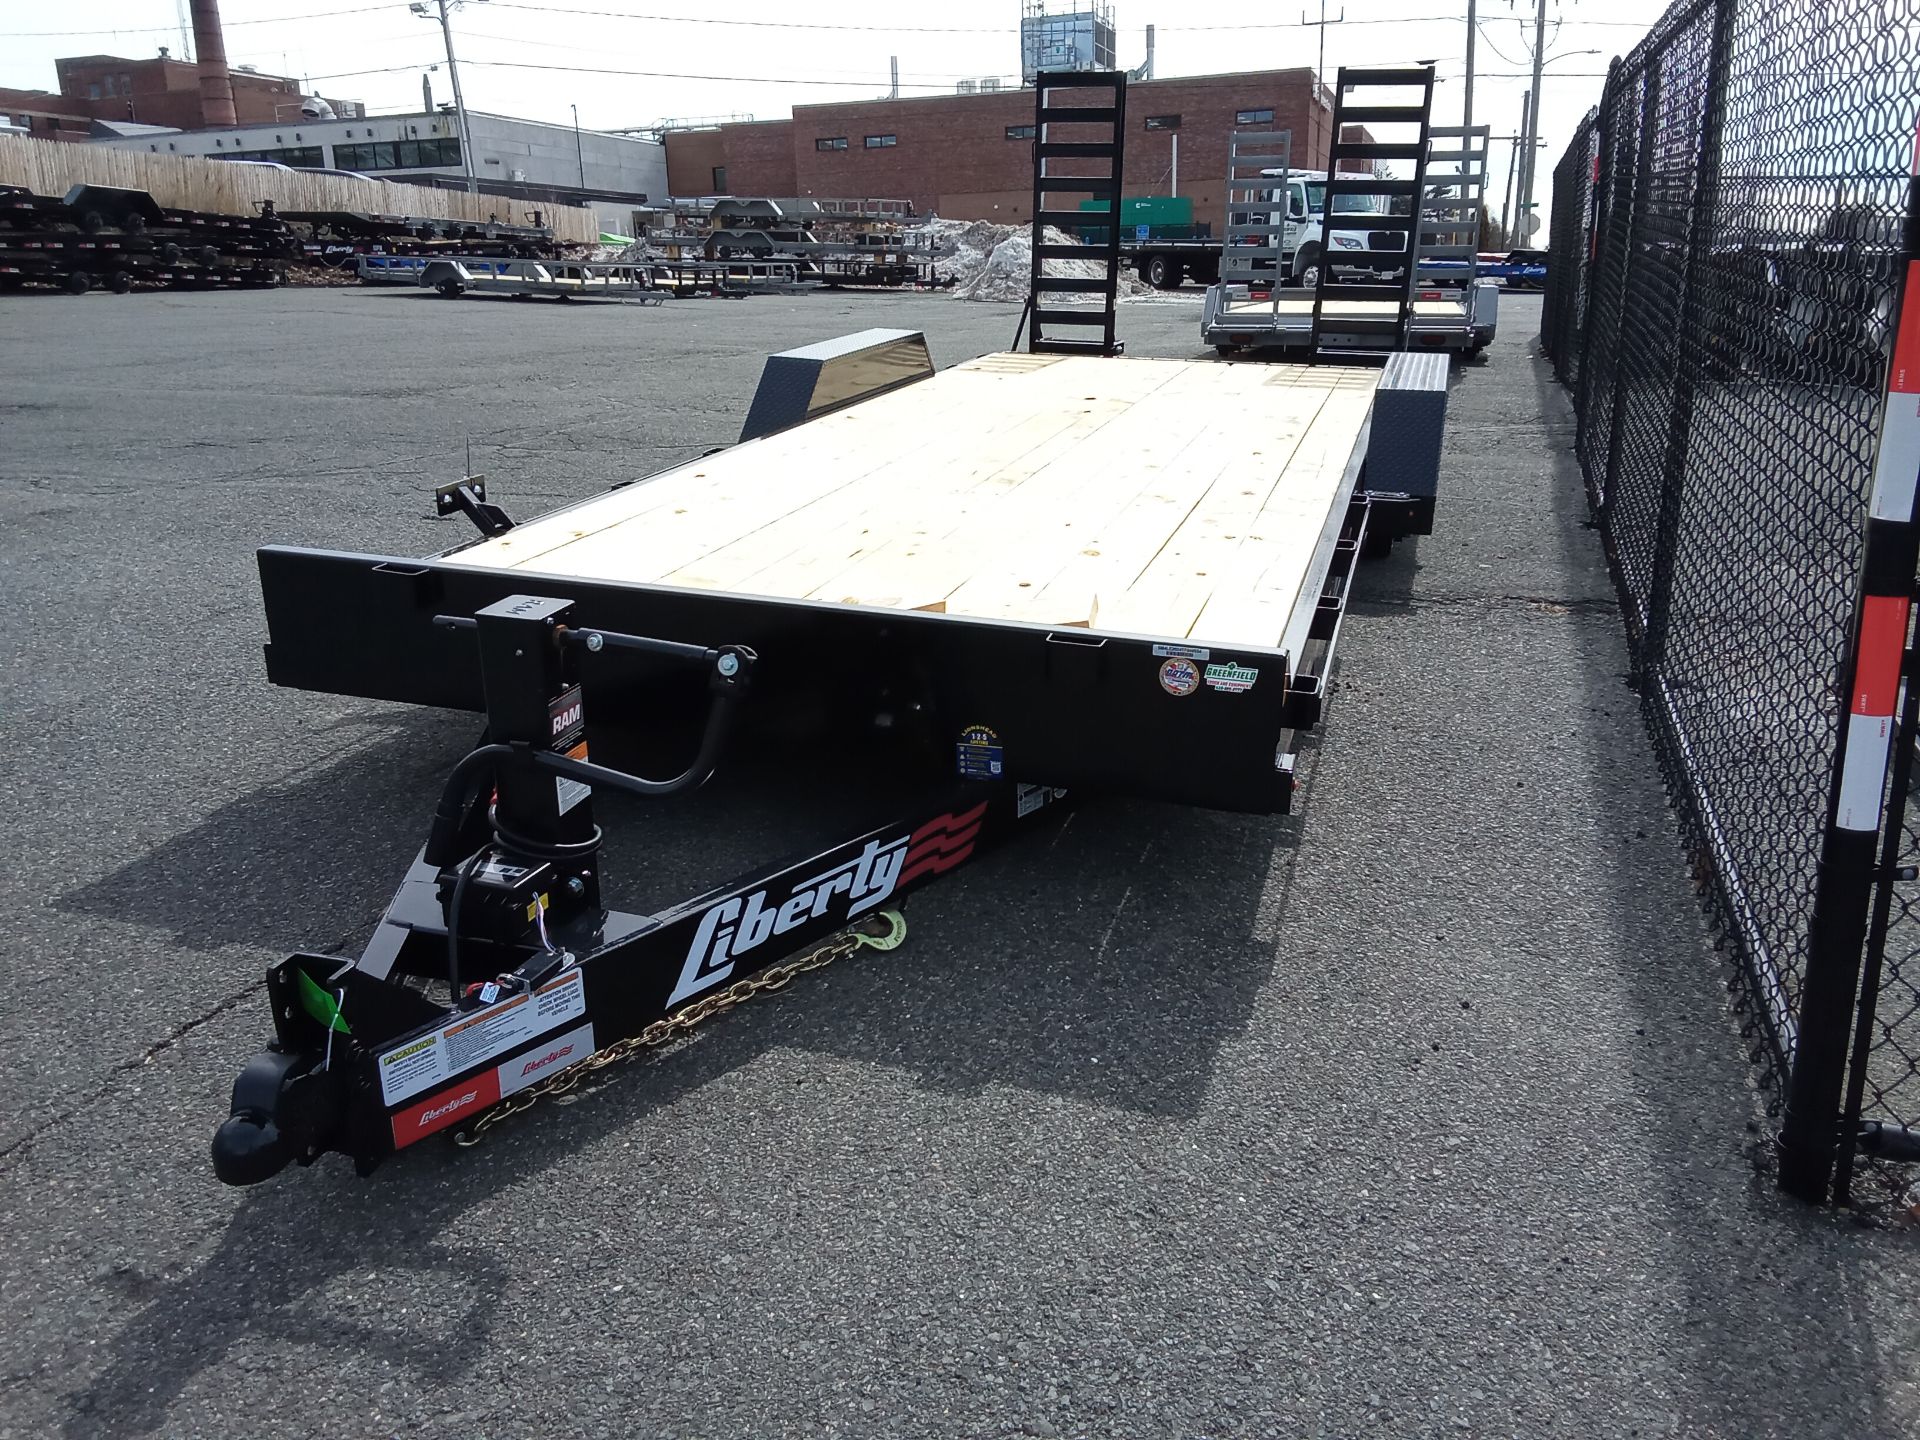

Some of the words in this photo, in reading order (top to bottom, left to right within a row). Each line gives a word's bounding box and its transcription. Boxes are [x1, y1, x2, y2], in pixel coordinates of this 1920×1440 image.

[1206, 667, 1257, 681] GREENFIELD
[553, 703, 581, 735] RAM
[961, 725, 998, 739] LIONSHEAD
[665, 834, 911, 1010] Liberty
[396, 1036, 437, 1060] CAUTION
[520, 1051, 561, 1077] Liberty
[418, 1097, 462, 1126] Liberty
